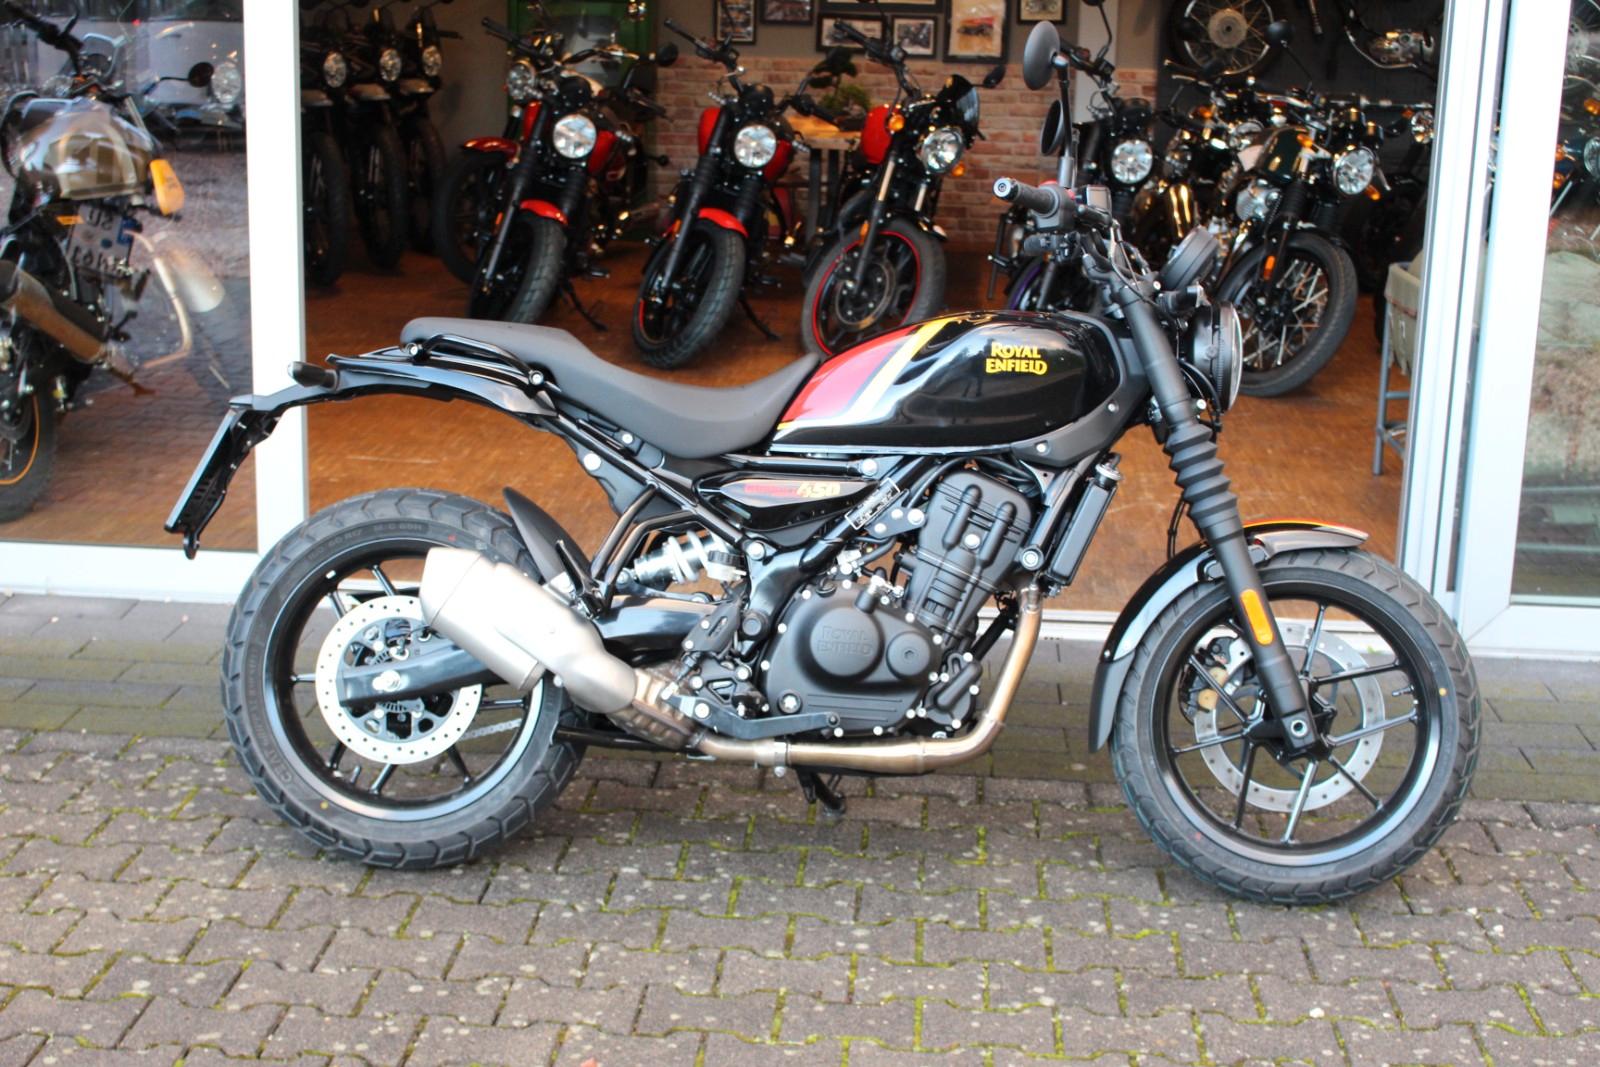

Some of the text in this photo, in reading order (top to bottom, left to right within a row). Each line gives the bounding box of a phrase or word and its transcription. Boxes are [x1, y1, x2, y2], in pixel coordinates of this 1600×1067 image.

[990, 341, 1041, 359] ROYAL
[985, 357, 1048, 375] ENFIELD
[822, 625, 869, 642] ROYAL
